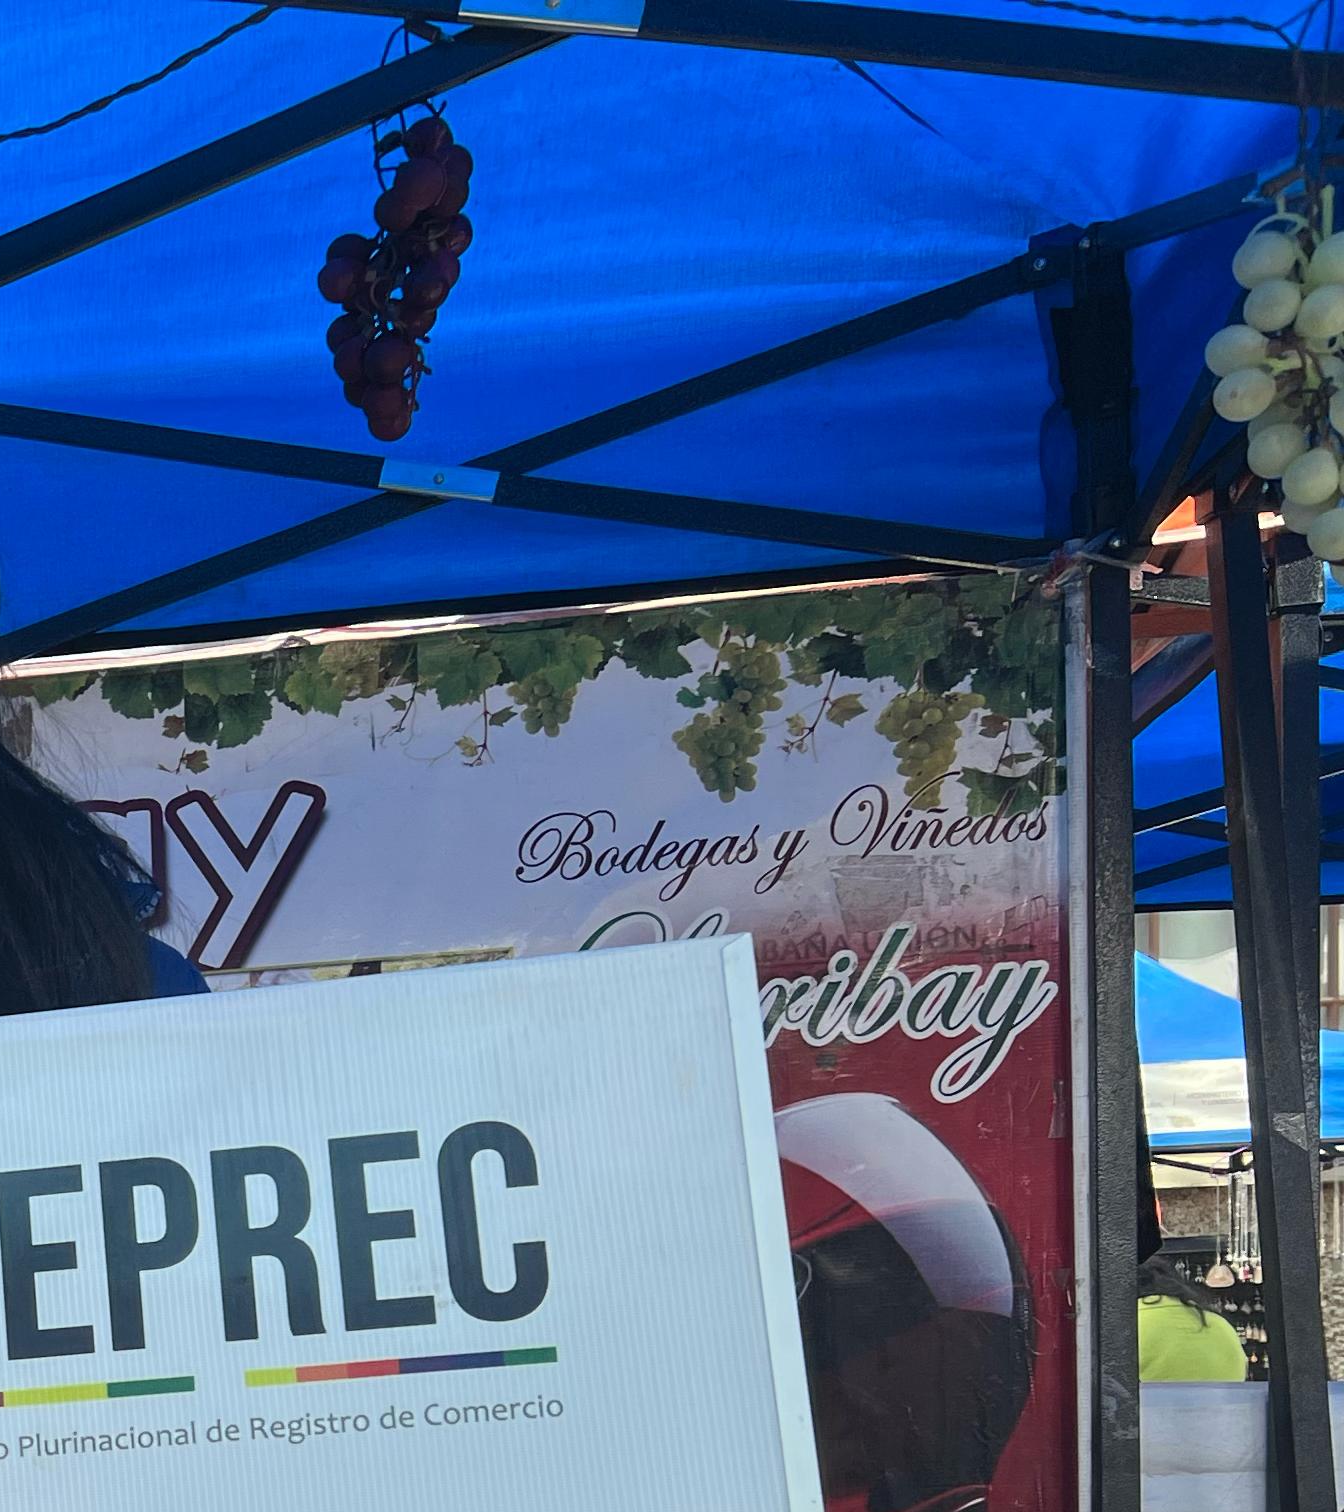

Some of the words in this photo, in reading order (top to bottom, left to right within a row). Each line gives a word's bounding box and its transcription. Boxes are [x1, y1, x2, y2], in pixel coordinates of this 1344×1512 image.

[515, 809, 759, 901] Bodegas
[755, 827, 808, 894] y
[830, 773, 1049, 860] Viñedos
[19, 1422, 197, 1457] Plurinacional
[206, 1418, 240, 1443] de
[249, 1408, 370, 1444] Registro
[379, 1404, 414, 1429] de
[424, 1394, 563, 1426] Comercio
